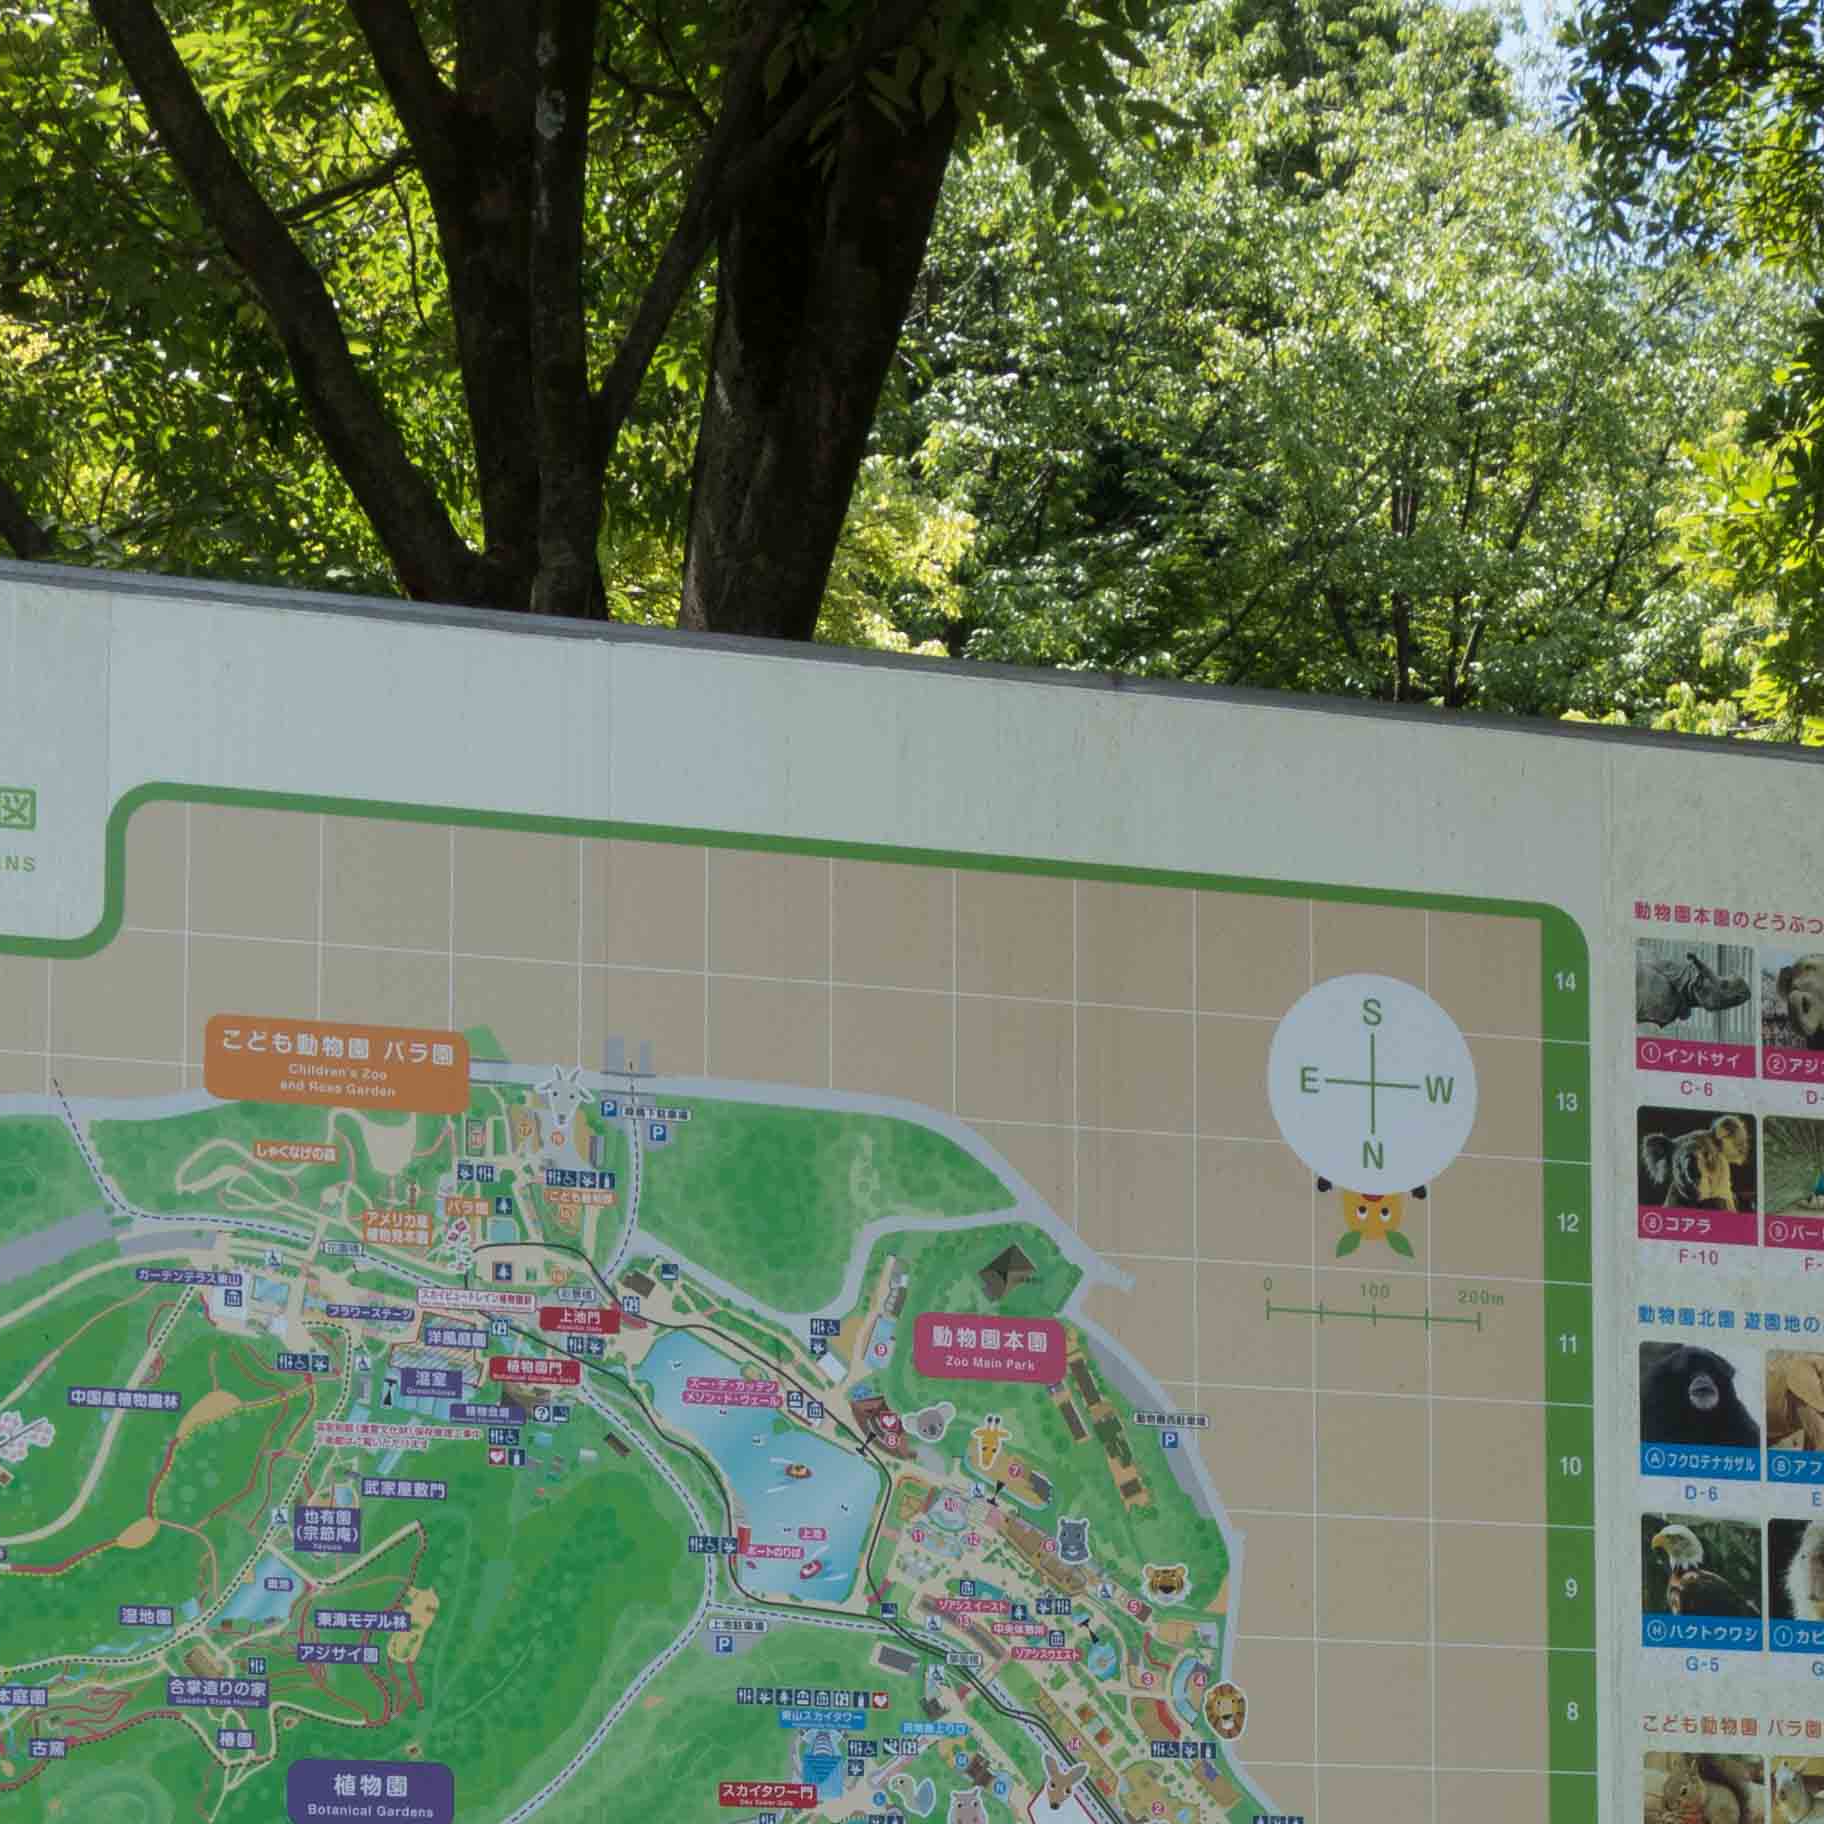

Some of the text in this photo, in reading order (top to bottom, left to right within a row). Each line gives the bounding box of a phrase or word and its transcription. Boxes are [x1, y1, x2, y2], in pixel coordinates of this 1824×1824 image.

[1554, 971, 1576, 990] 14
[1362, 998, 1382, 1026] S
[223, 1029, 453, 1065] こども動物園 バラ園
[362, 1069, 387, 1081] Zoo
[1300, 1066, 1320, 1093] E
[1425, 1076, 1454, 1104] W
[1680, 1080, 1714, 1097] C-6
[1556, 1093, 1578, 1111] 13
[1362, 1141, 1384, 1170] N
[1557, 1214, 1578, 1232] 12
[1679, 1248, 1720, 1266] F-10
[1359, 1284, 1390, 1299] 100
[1638, 1304, 1735, 1329] 動物園北園
[933, 1325, 1048, 1352] 動物園本園
[1559, 1336, 1577, 1353] 11
[945, 1355, 1035, 1370] Zoo Main Park
[1559, 1457, 1582, 1476] 10
[1684, 1485, 1718, 1501] D-6
[1565, 1578, 1578, 1598] 9
[1566, 1702, 1579, 1721] 8
[1642, 1715, 1758, 1737] こども動物園
[334, 1773, 408, 1797] 植物園
[308, 1803, 434, 1818] Botanical Gardens
